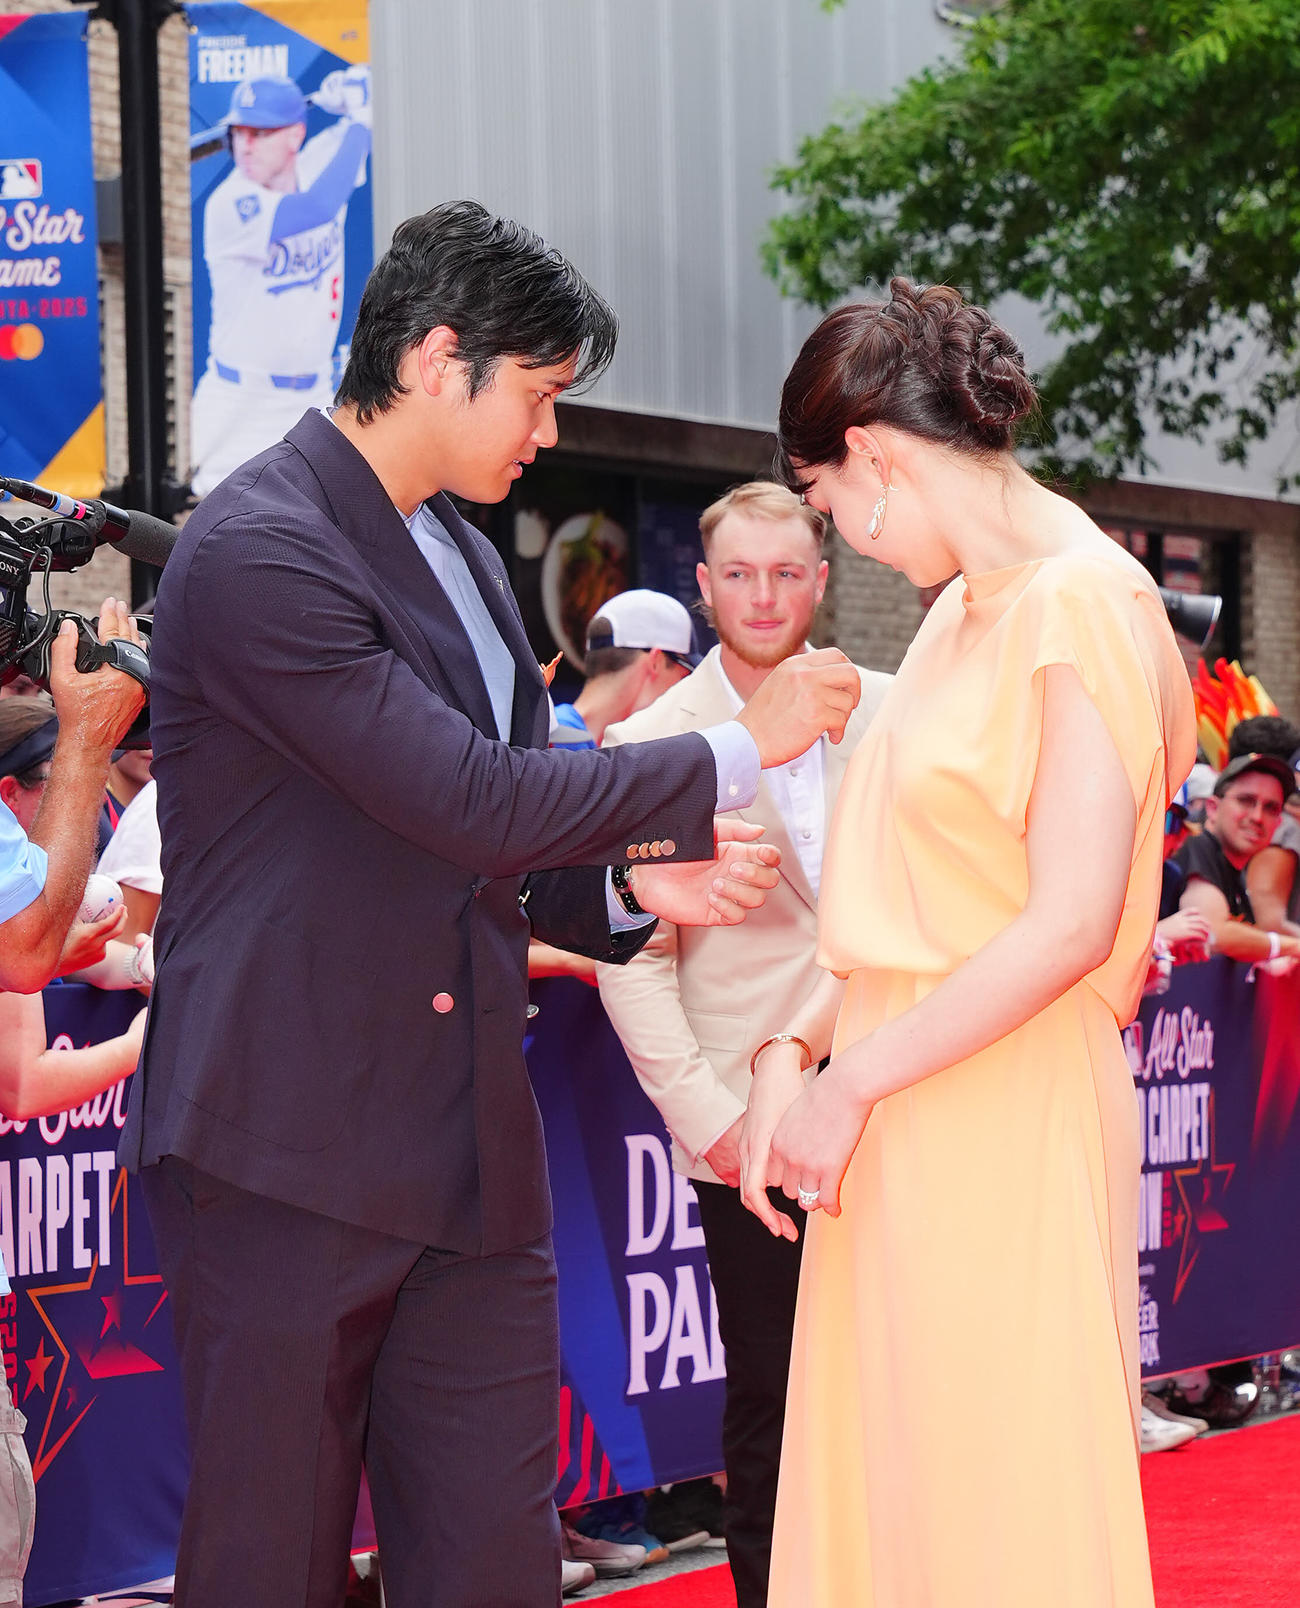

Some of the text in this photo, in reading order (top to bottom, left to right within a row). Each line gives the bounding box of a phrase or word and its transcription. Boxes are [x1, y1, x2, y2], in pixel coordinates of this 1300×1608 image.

[198, 44, 289, 83] FREEMAN
[6, 200, 85, 252] Star
[38, 297, 88, 320] 2025
[1148, 1082, 1211, 1166] CARPET
[625, 1264, 727, 1396] PA
